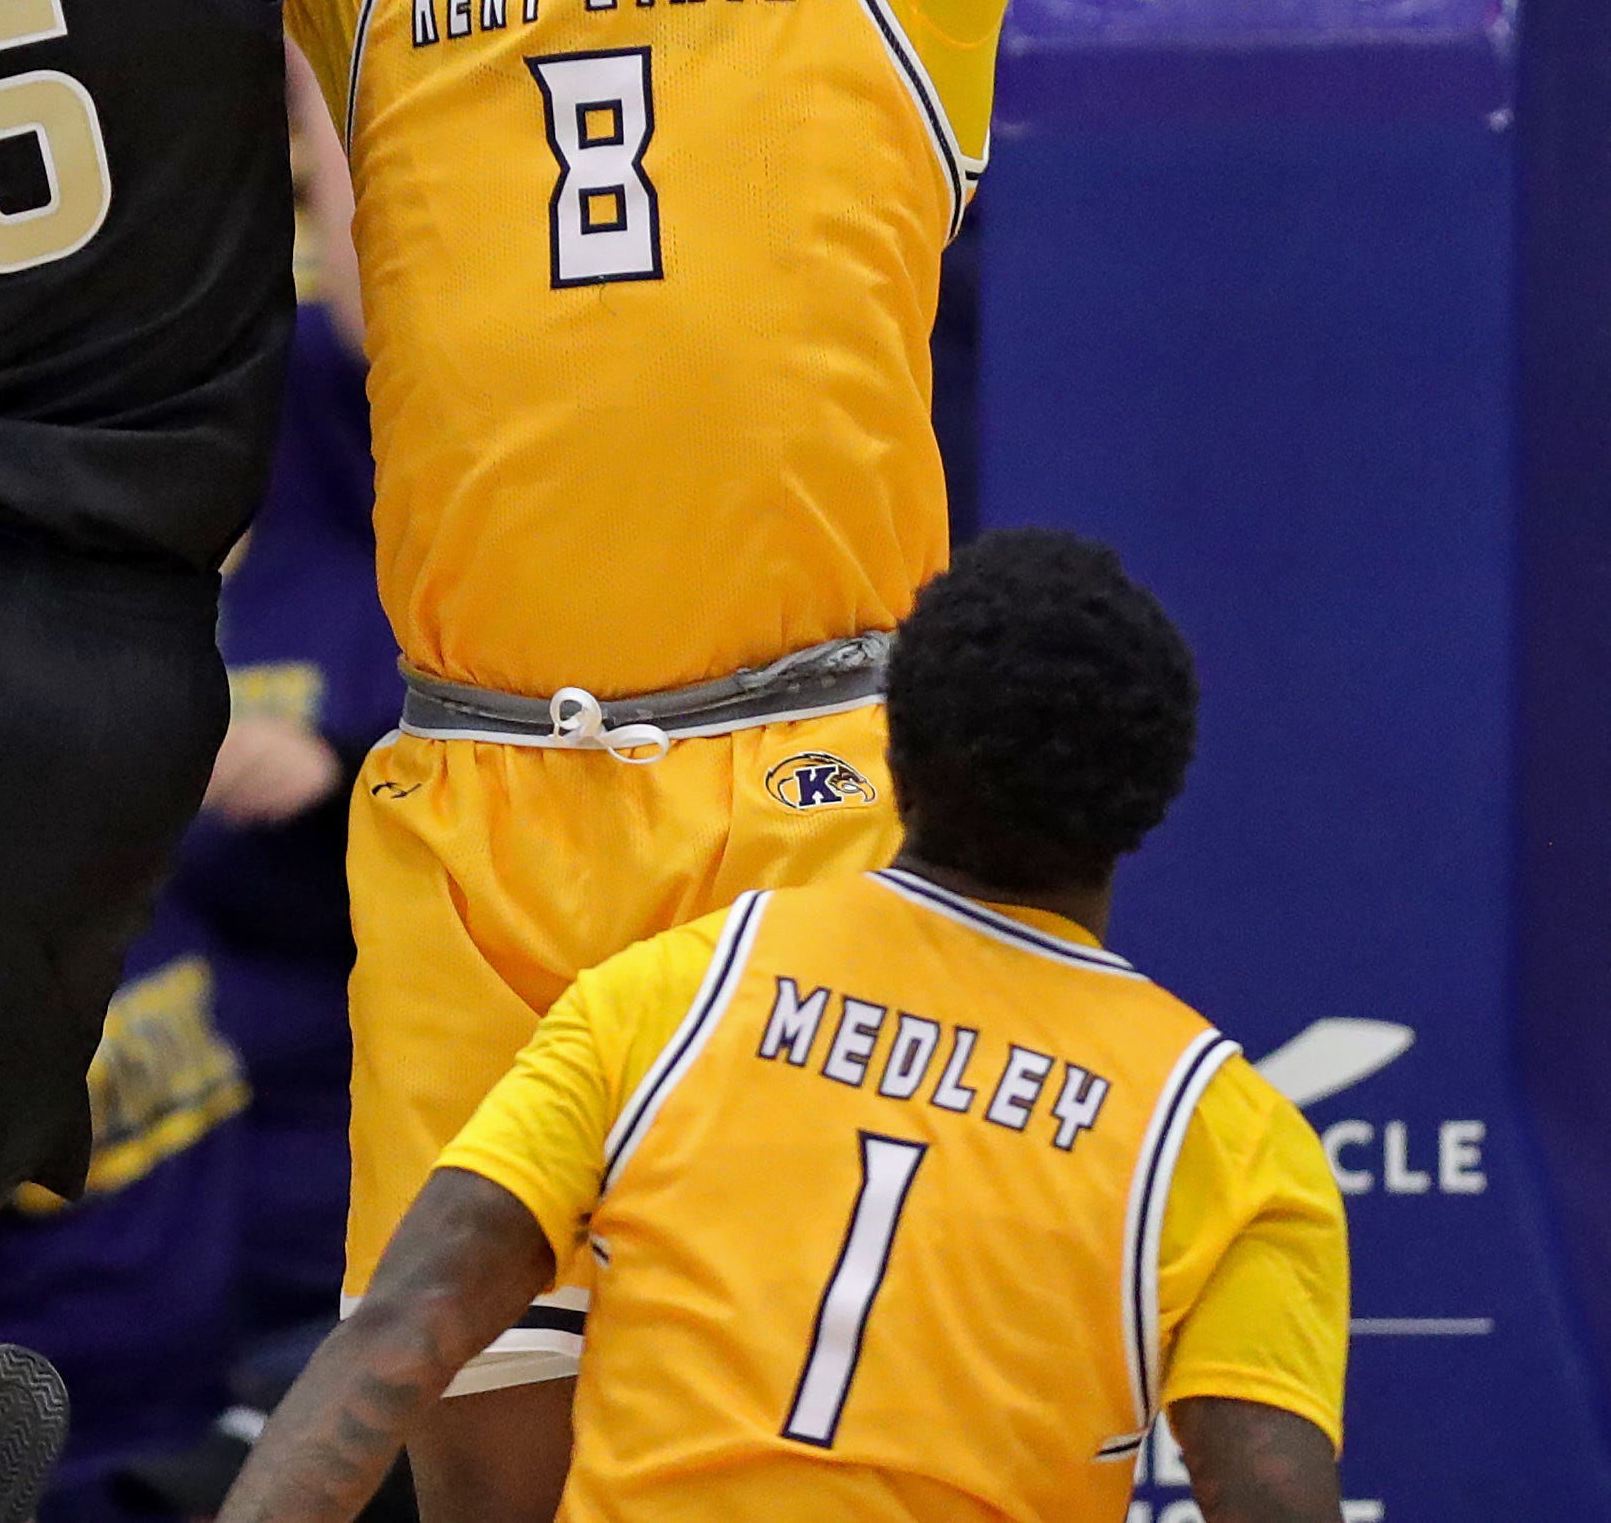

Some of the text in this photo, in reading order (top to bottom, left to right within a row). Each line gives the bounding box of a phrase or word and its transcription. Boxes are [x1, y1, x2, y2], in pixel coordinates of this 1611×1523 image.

[523, 45, 664, 290] 8
[756, 974, 1113, 1153] MEDLEY
[780, 1130, 930, 1450] 1
